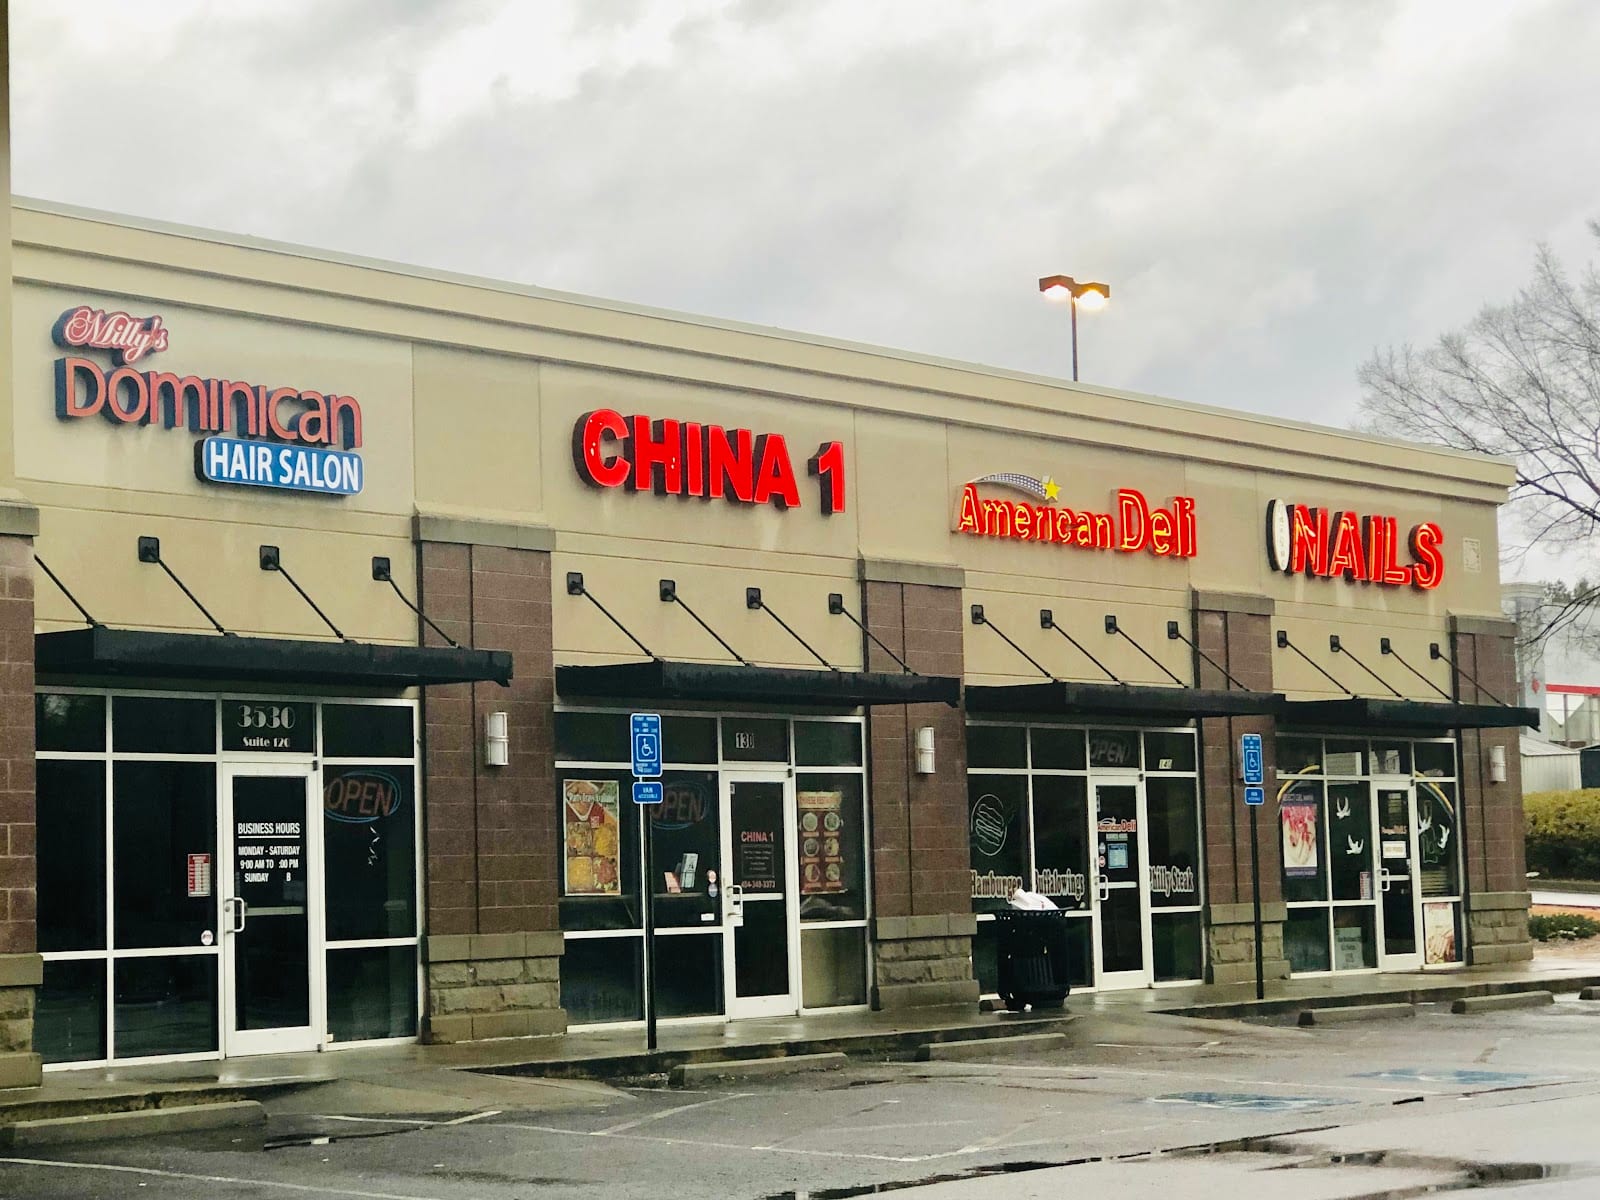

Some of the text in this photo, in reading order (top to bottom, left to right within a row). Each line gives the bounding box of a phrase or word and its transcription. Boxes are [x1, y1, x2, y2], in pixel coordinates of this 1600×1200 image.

[64, 307, 168, 362] Milly's
[63, 357, 363, 449] Dominican
[209, 441, 360, 492] HAIR SALON
[582, 408, 846, 514] CHINA 1
[957, 482, 1116, 551] American
[1116, 488, 1197, 558] Deli
[1291, 503, 1444, 590] NAILS
[237, 704, 297, 729] 3530
[242, 736, 271, 748] Suite
[736, 732, 755, 749] 130
[326, 777, 394, 817] OPEN
[237, 822, 301, 835] BUSINESS HOURS
[741, 831, 775, 843] CHINA 1
[238, 846, 264, 856] MONDAY
[269, 845, 301, 856] SATURDAY
[254, 859, 265, 869] AM
[265, 859, 275, 869] TO
[288, 858, 299, 869] PM
[244, 872, 270, 883] SUNDAY
